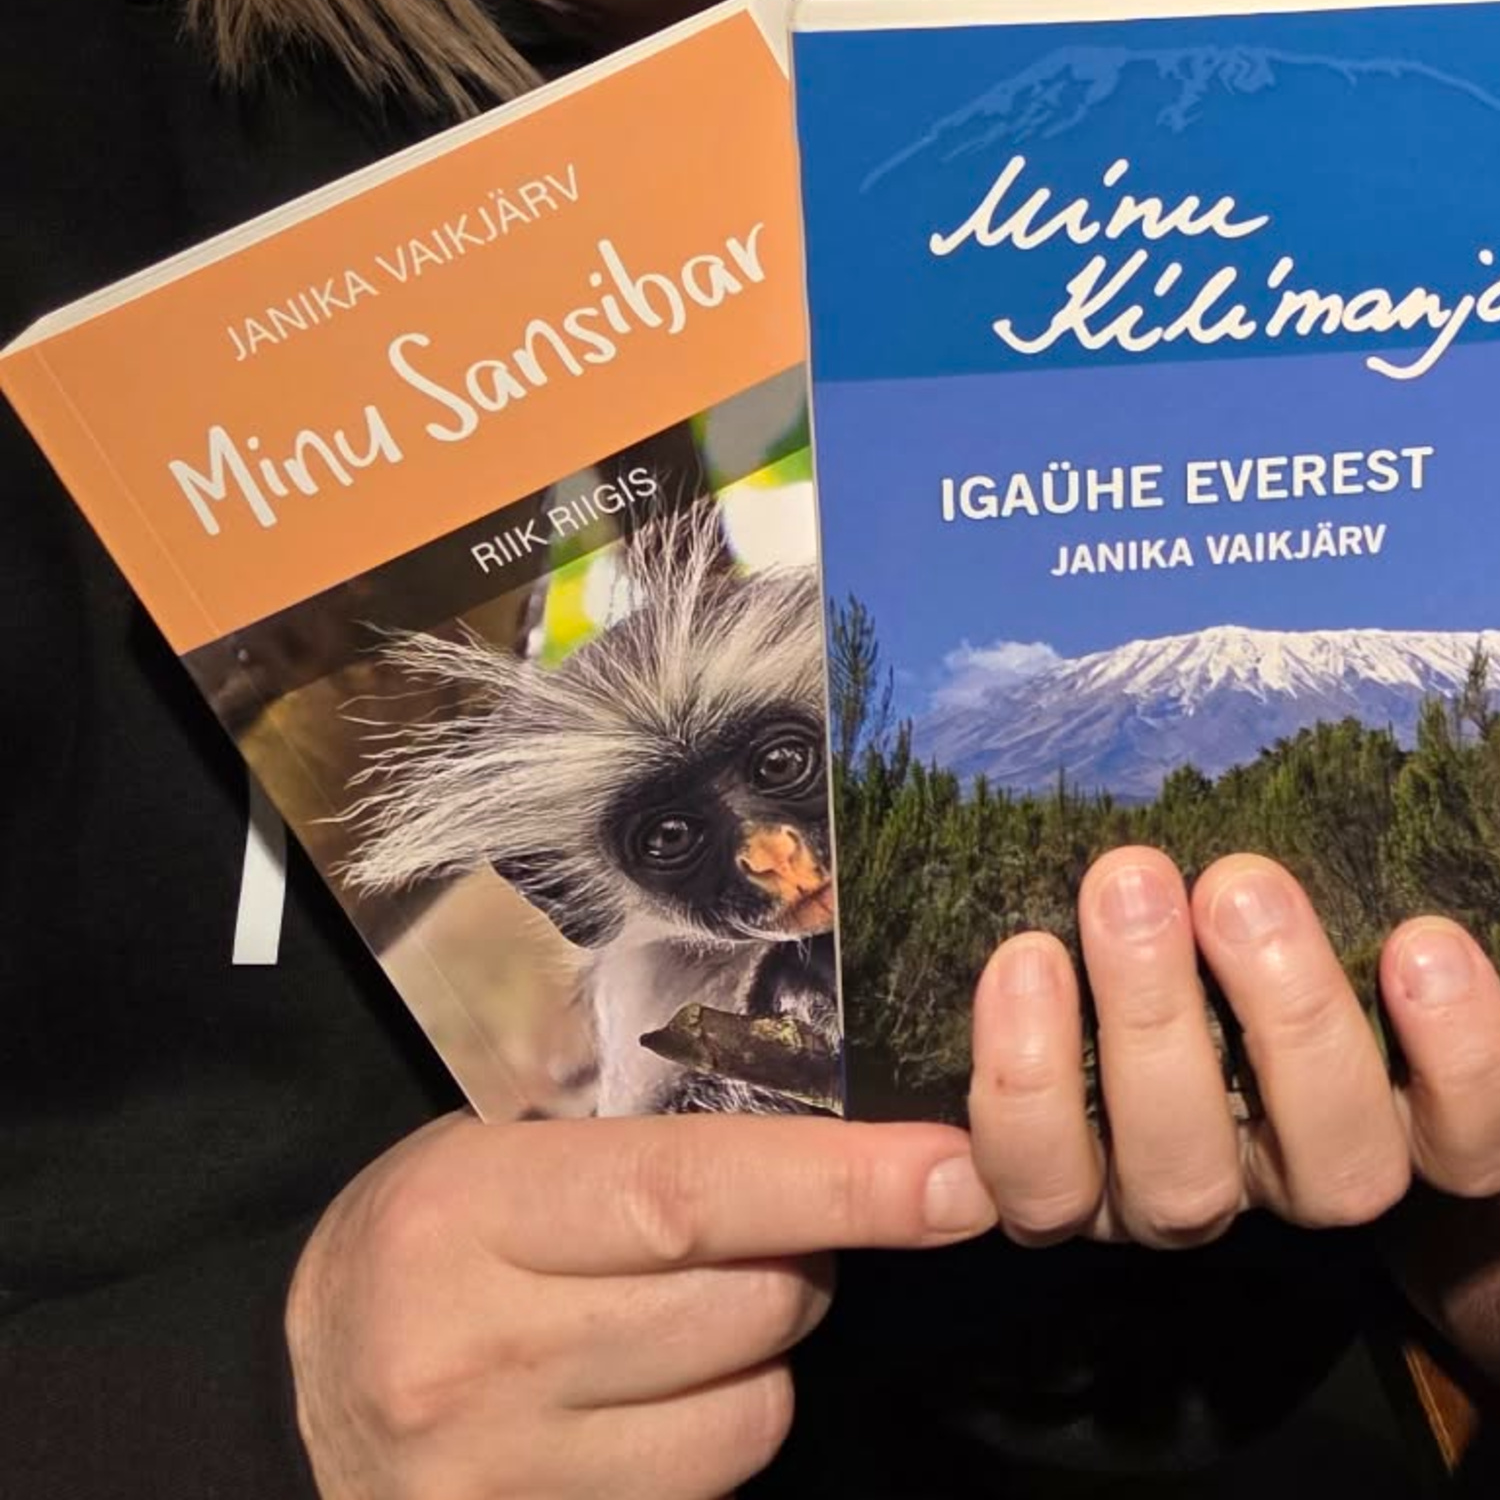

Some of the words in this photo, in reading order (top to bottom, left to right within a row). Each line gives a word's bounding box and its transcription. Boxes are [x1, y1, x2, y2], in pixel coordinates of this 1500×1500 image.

[929, 155, 1270, 257] Minu
[227, 270, 380, 362] JANIKA
[375, 163, 580, 284] VAIKJÄRV
[168, 405, 404, 536] Minu
[387, 223, 768, 443] Sansibar
[470, 518, 549, 574] RIIK
[547, 467, 658, 538] RIIGIS
[941, 461, 1165, 522] IGAÜHE
[1186, 446, 1434, 504] EVEREST
[1050, 537, 1194, 576] JANIKA
[1206, 522, 1387, 565] VAIKJÄRV
